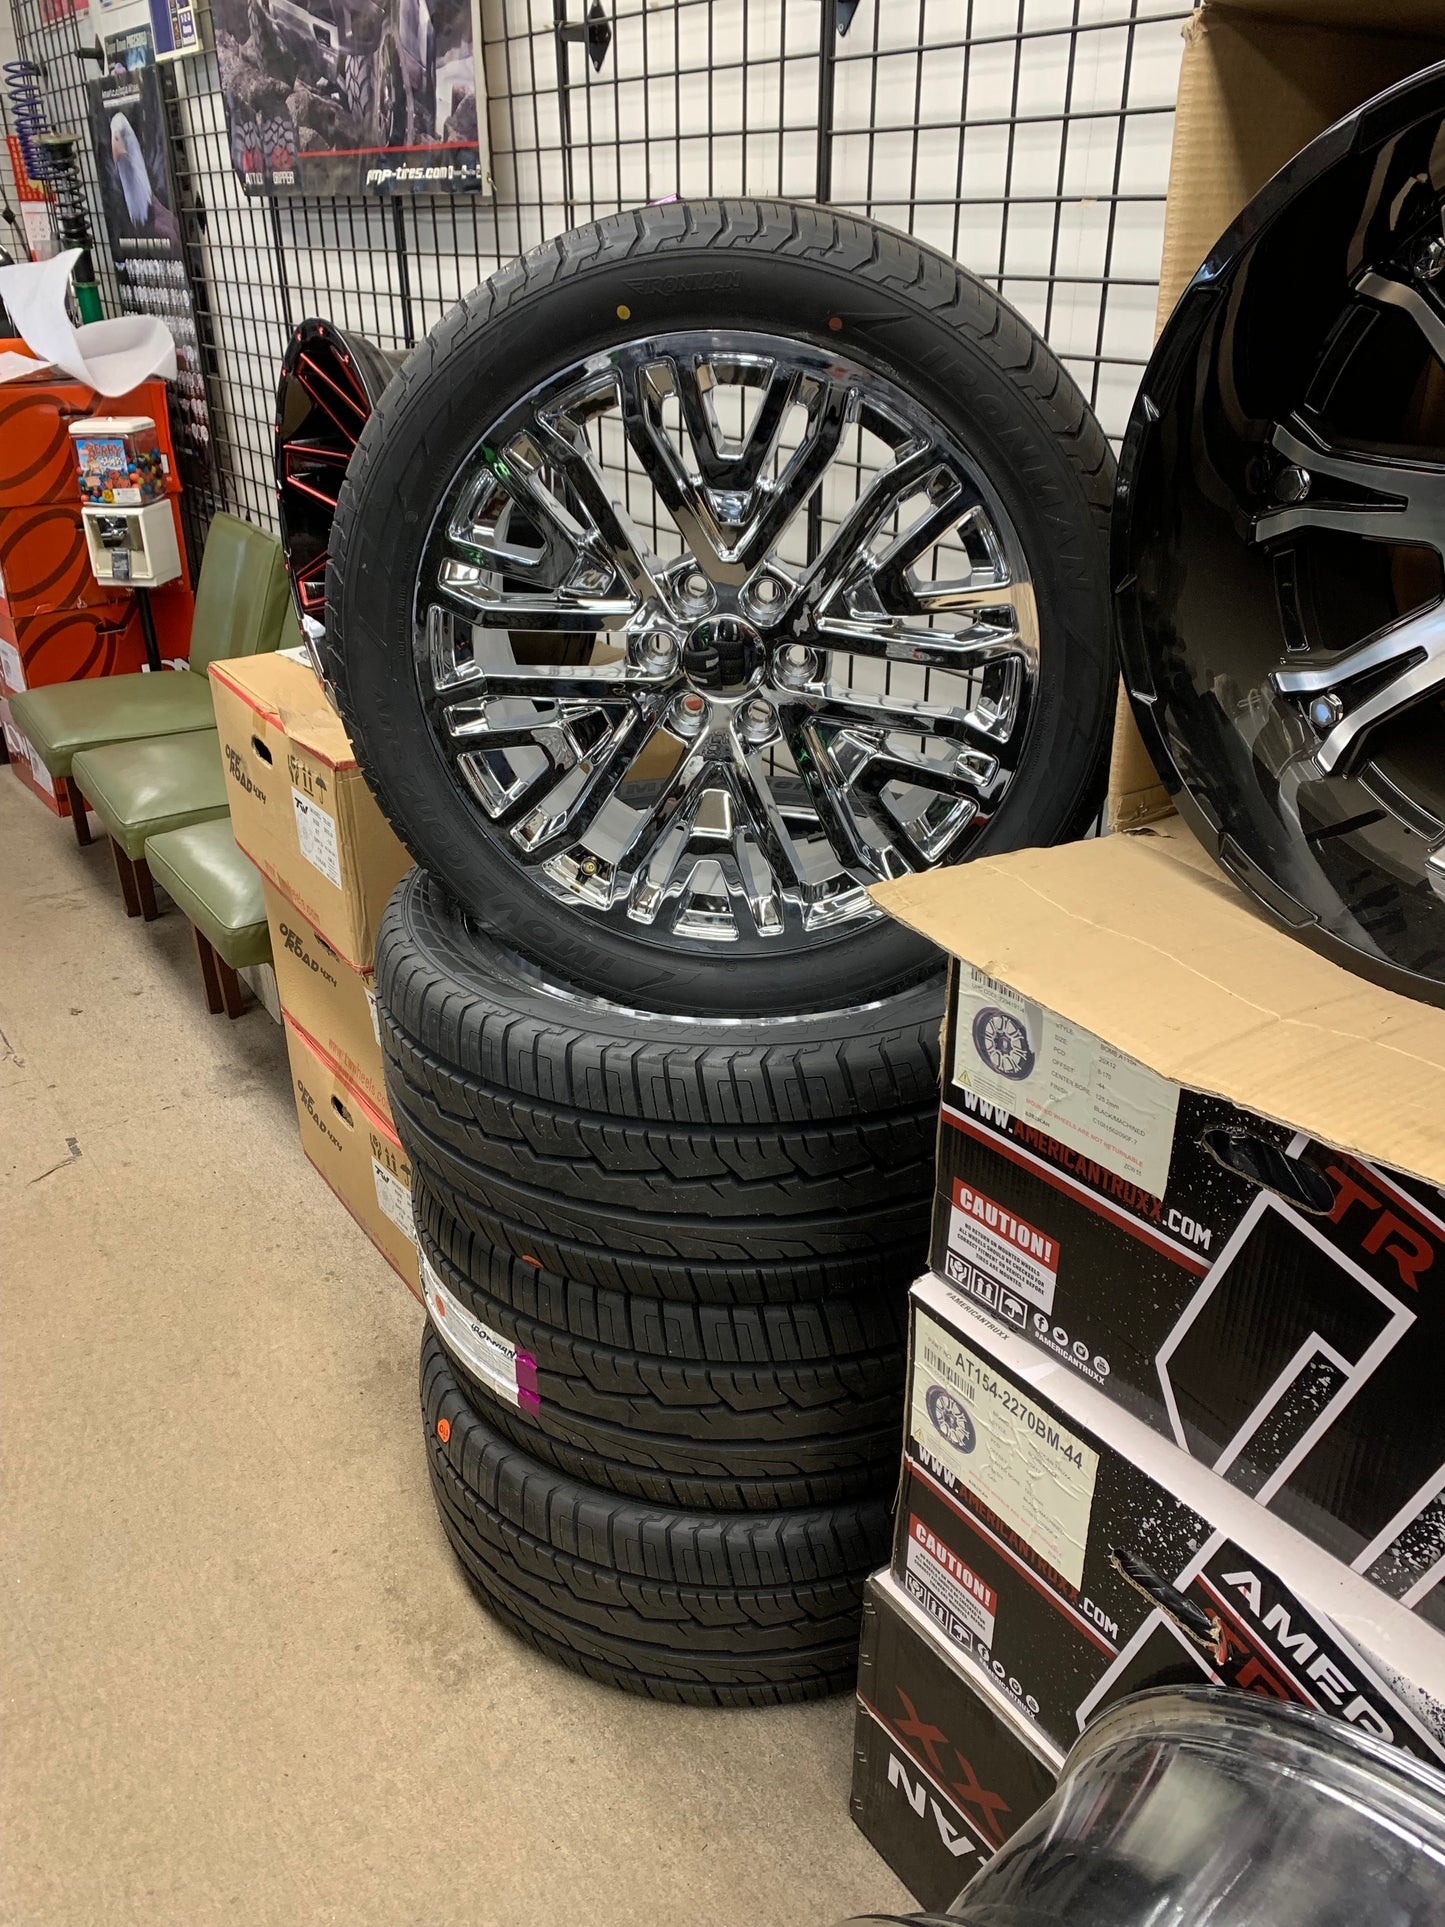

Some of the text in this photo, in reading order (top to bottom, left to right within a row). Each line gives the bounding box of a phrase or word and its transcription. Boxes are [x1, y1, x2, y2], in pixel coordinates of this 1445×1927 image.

[225, 744, 241, 771] OFF
[279, 922, 303, 947] OFF
[284, 935, 319, 973] ROAD
[297, 1079, 315, 1106] OFF
[960, 1187, 1053, 1263] CAUTION!
[1034, 1331, 1106, 1386] #AMERICANTRUXX
[955, 1352, 1083, 1469] AT154-2270BM-44
[915, 1523, 992, 1607] CAUTION!
